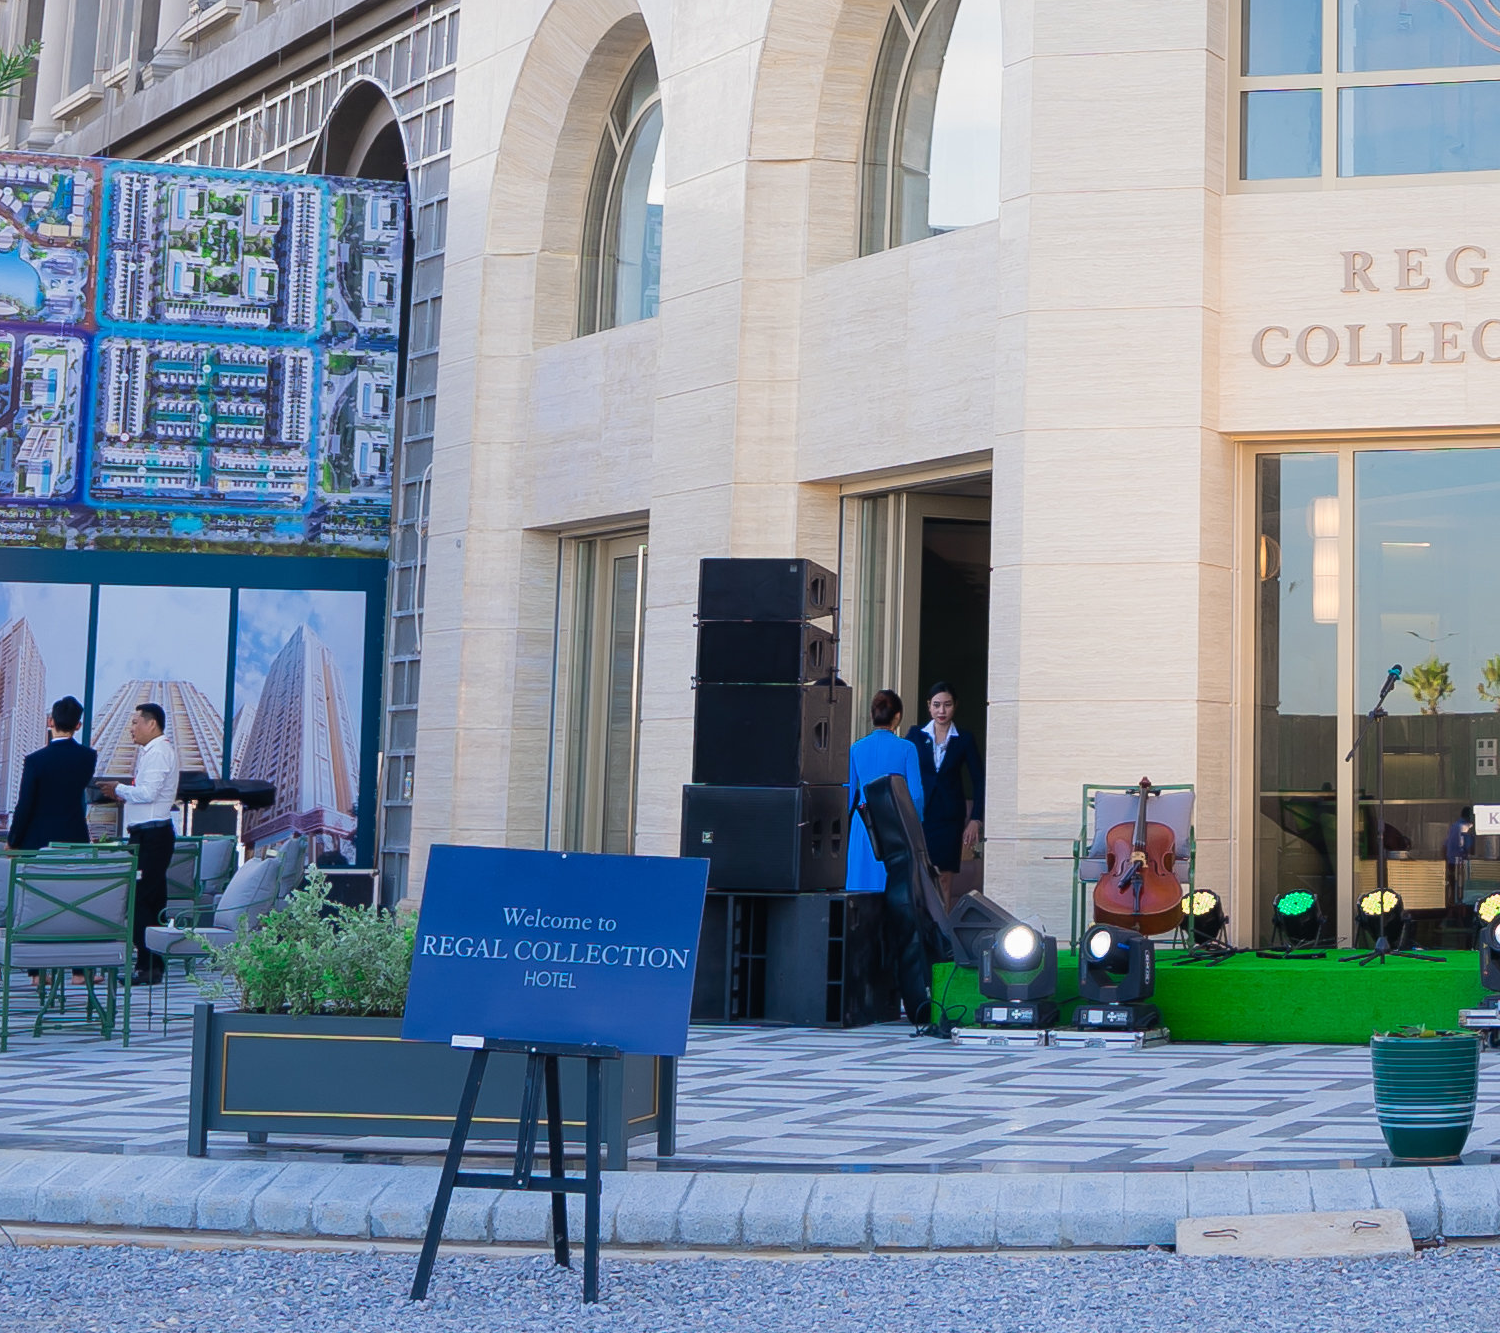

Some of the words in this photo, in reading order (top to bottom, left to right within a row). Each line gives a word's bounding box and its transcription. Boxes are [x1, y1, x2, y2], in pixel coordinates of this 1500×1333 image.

[503, 907, 593, 932] Welcome
[598, 917, 618, 932] to
[421, 934, 509, 961] REGAL
[514, 940, 691, 970] COLLECTION
[523, 970, 577, 989] HOTEL
